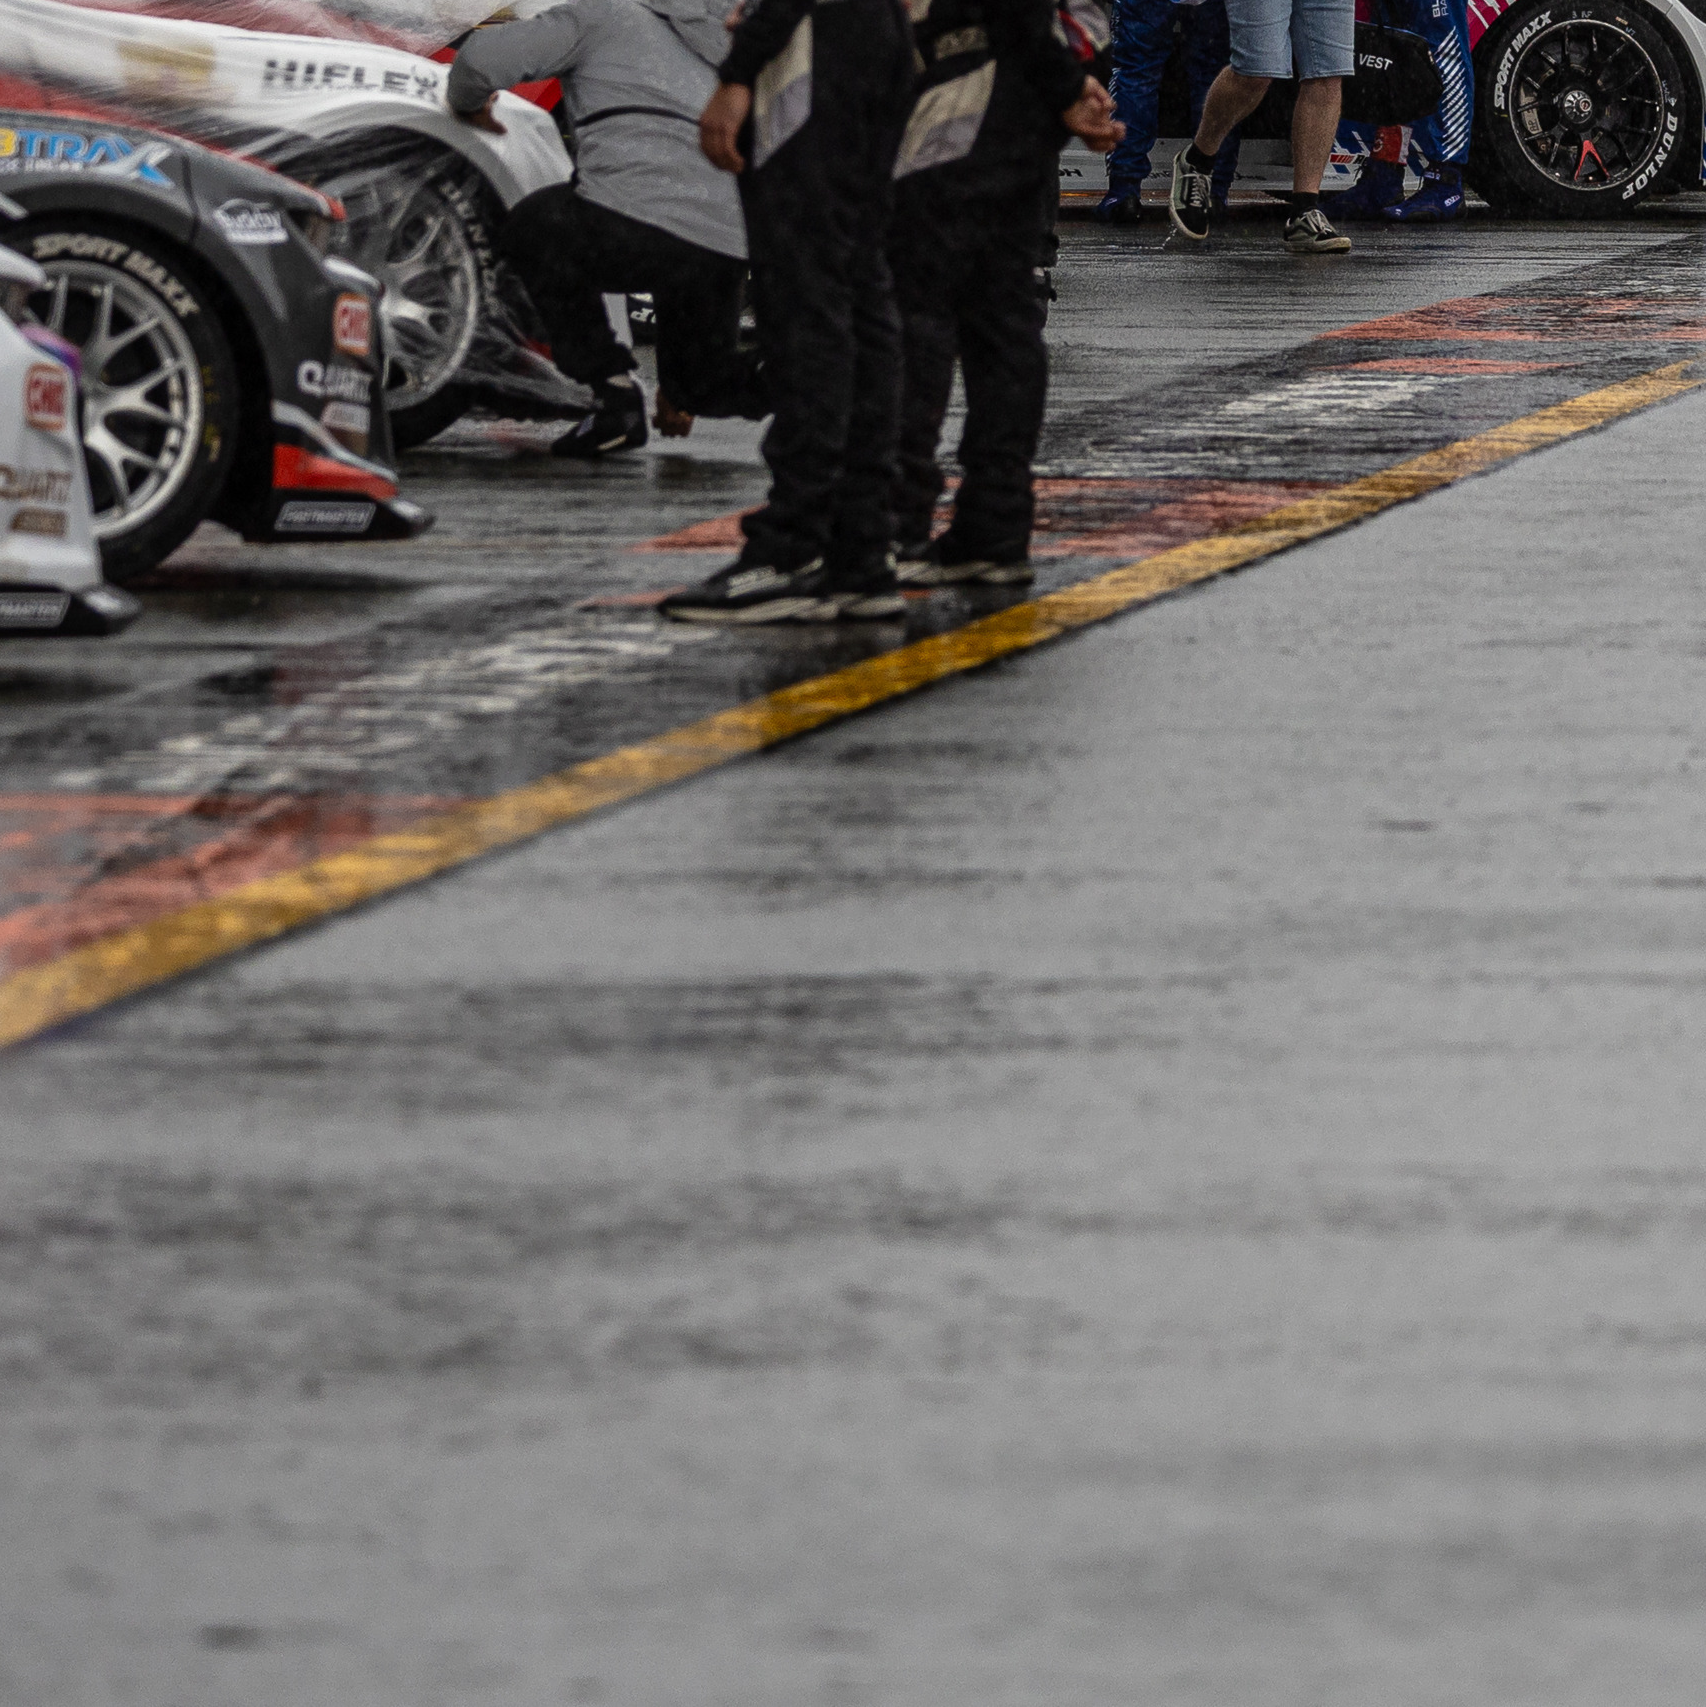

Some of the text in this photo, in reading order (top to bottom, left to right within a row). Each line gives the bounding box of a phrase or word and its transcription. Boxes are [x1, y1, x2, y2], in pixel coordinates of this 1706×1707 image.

[1359, 53, 1393, 70] VEST
[1494, 11, 1552, 109] SPORT MAXX
[1621, 115, 1678, 199] DUNLOP
[33, 234, 200, 317] SPORT MAXX
